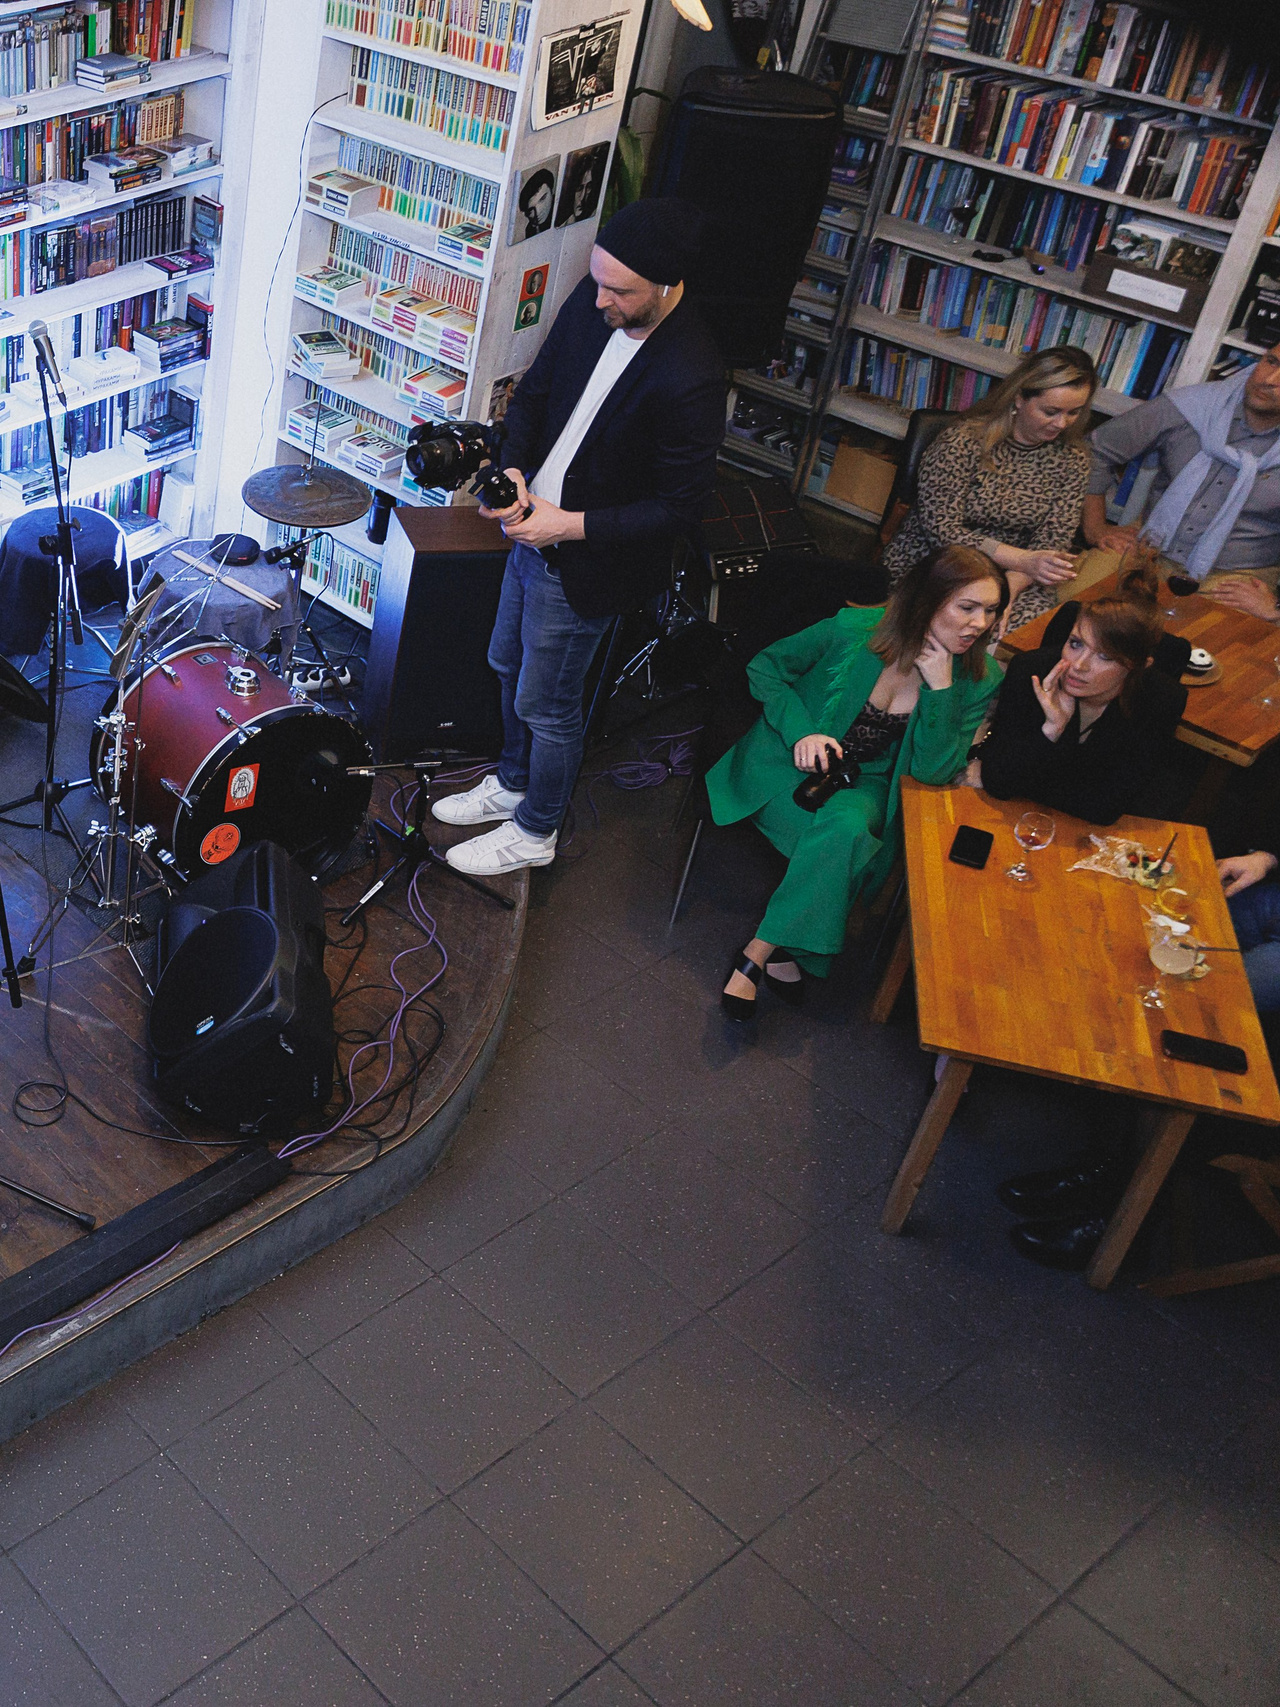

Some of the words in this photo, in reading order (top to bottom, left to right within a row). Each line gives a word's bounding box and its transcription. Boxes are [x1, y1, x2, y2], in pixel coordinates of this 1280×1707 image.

[478, 0, 490, 31] ГОМЕР
[545, 109, 569, 121] VAN
[367, 433, 395, 451] ЭКО
